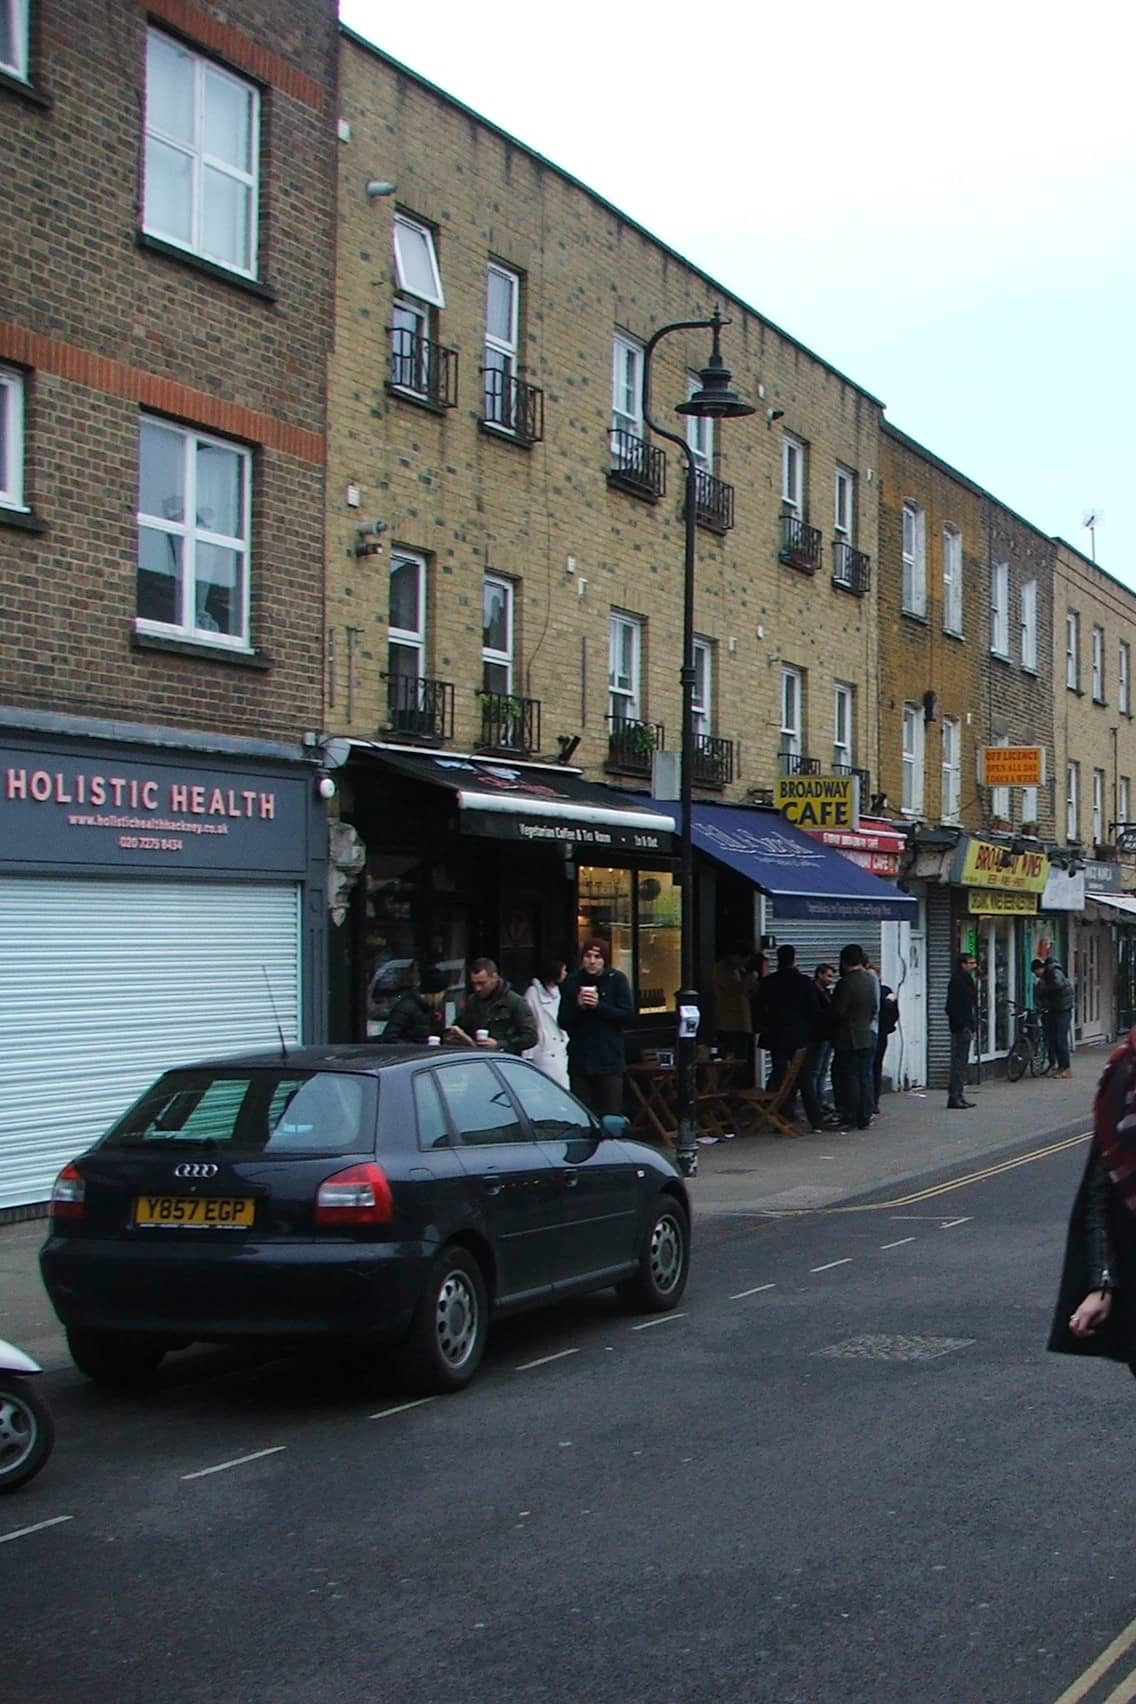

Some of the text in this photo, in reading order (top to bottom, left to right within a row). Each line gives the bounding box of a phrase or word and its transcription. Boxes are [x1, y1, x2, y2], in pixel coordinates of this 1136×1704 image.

[7, 768, 276, 820] HOLISTIC HEALTH
[780, 781, 849, 798] BROADWAY
[783, 801, 849, 825] CAFE
[119, 836, 138, 849] 020
[148, 1199, 245, 1221] Y857 EGP
